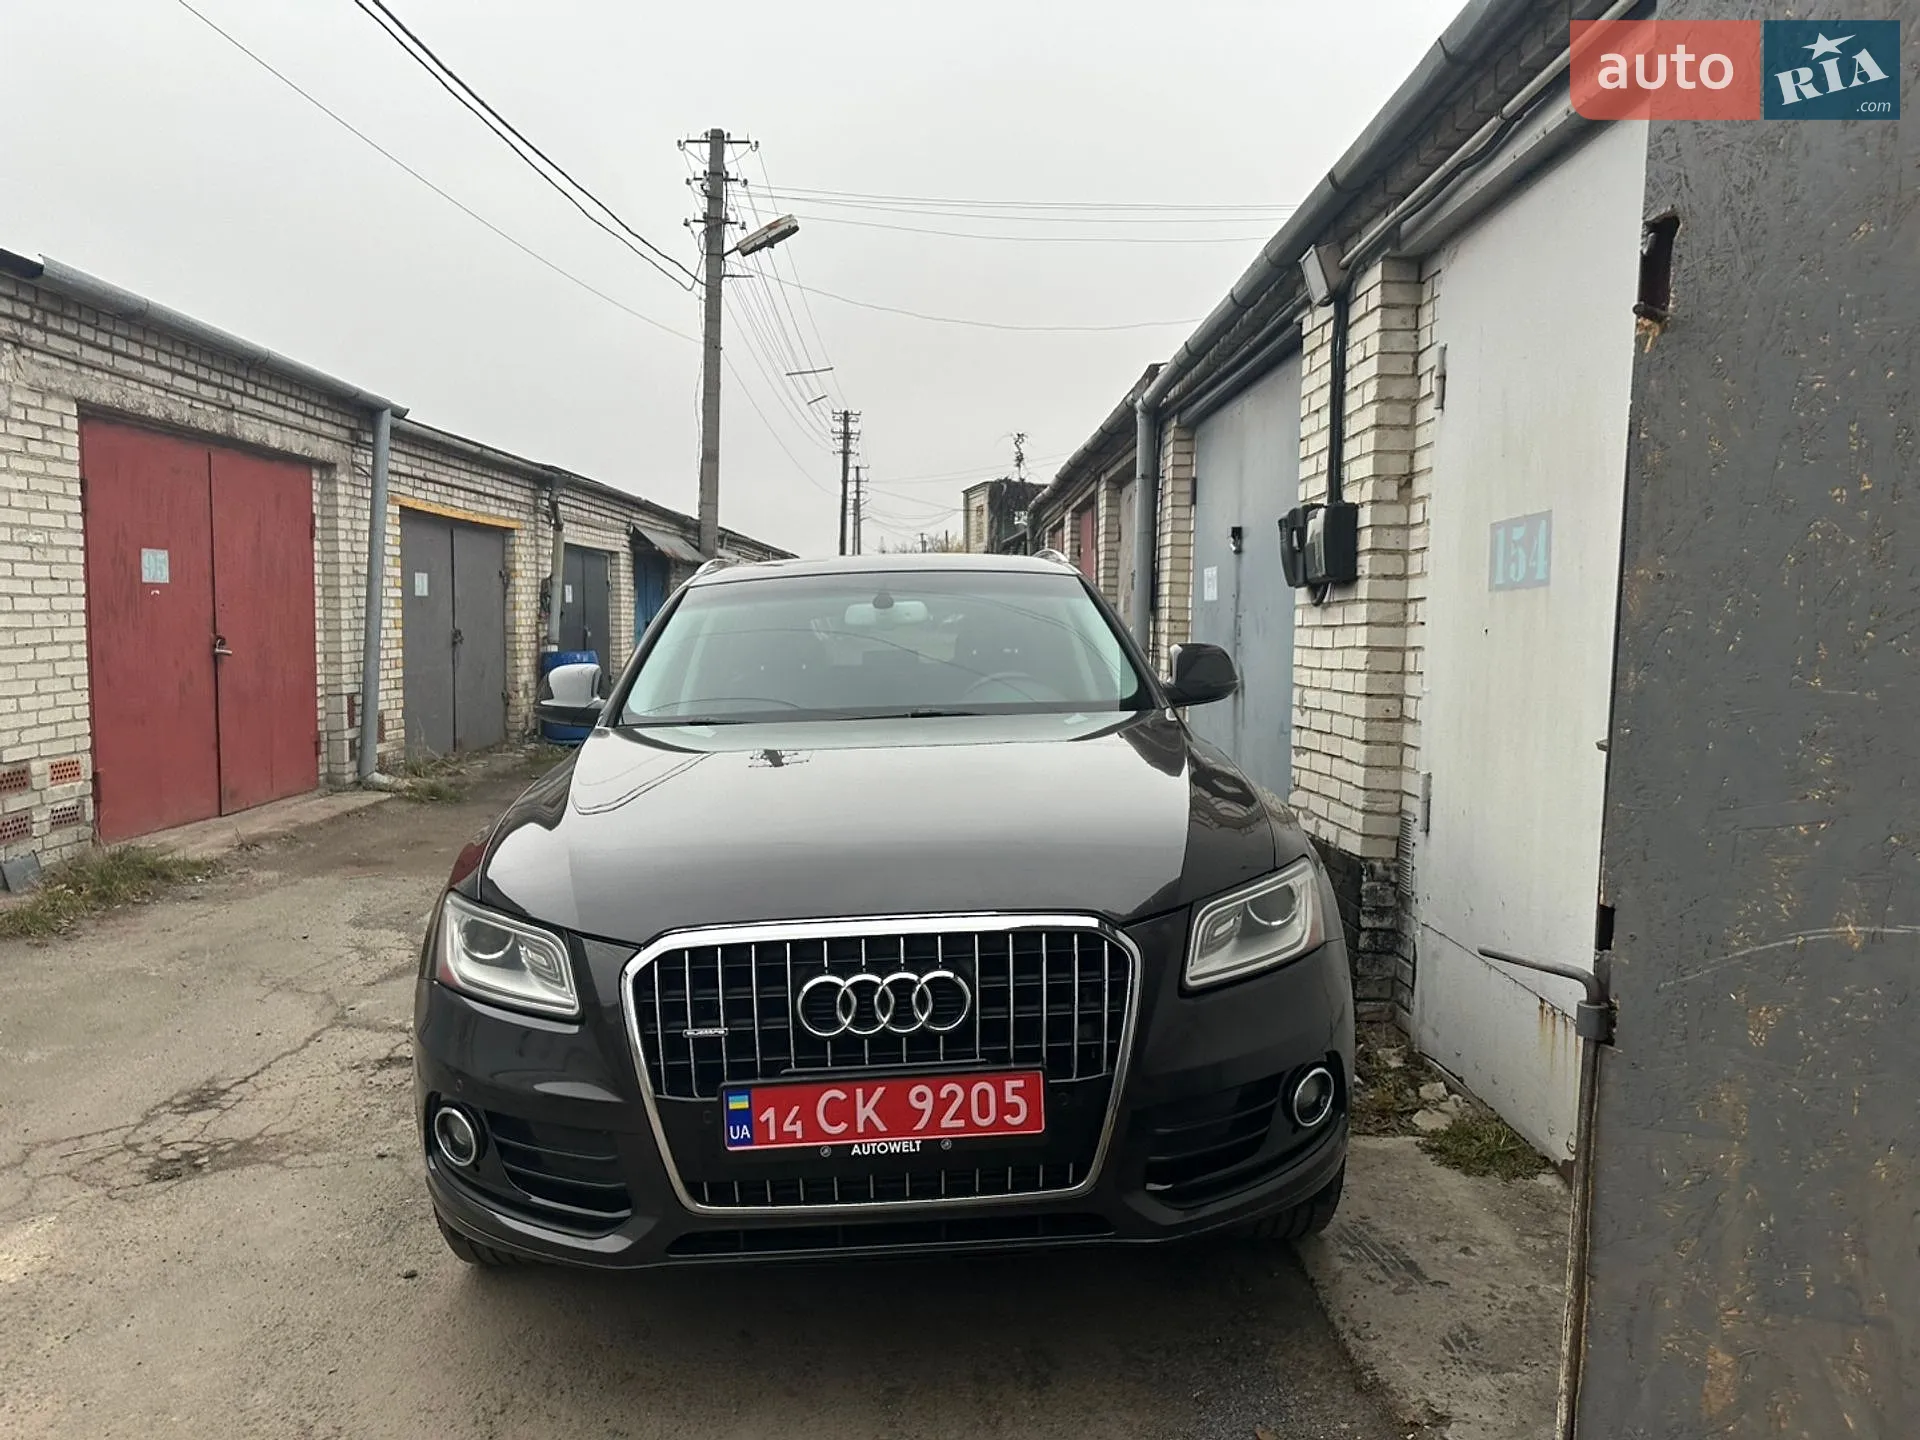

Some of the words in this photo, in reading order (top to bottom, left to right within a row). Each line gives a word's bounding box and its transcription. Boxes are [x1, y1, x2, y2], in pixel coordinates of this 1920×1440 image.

[1495, 519, 1547, 584] 154
[759, 1105, 803, 1140] 14
[816, 1086, 888, 1135] CK
[908, 1079, 1028, 1131] 9205
[729, 1124, 751, 1141] UA
[851, 1140, 922, 1156] AUTOWELT
